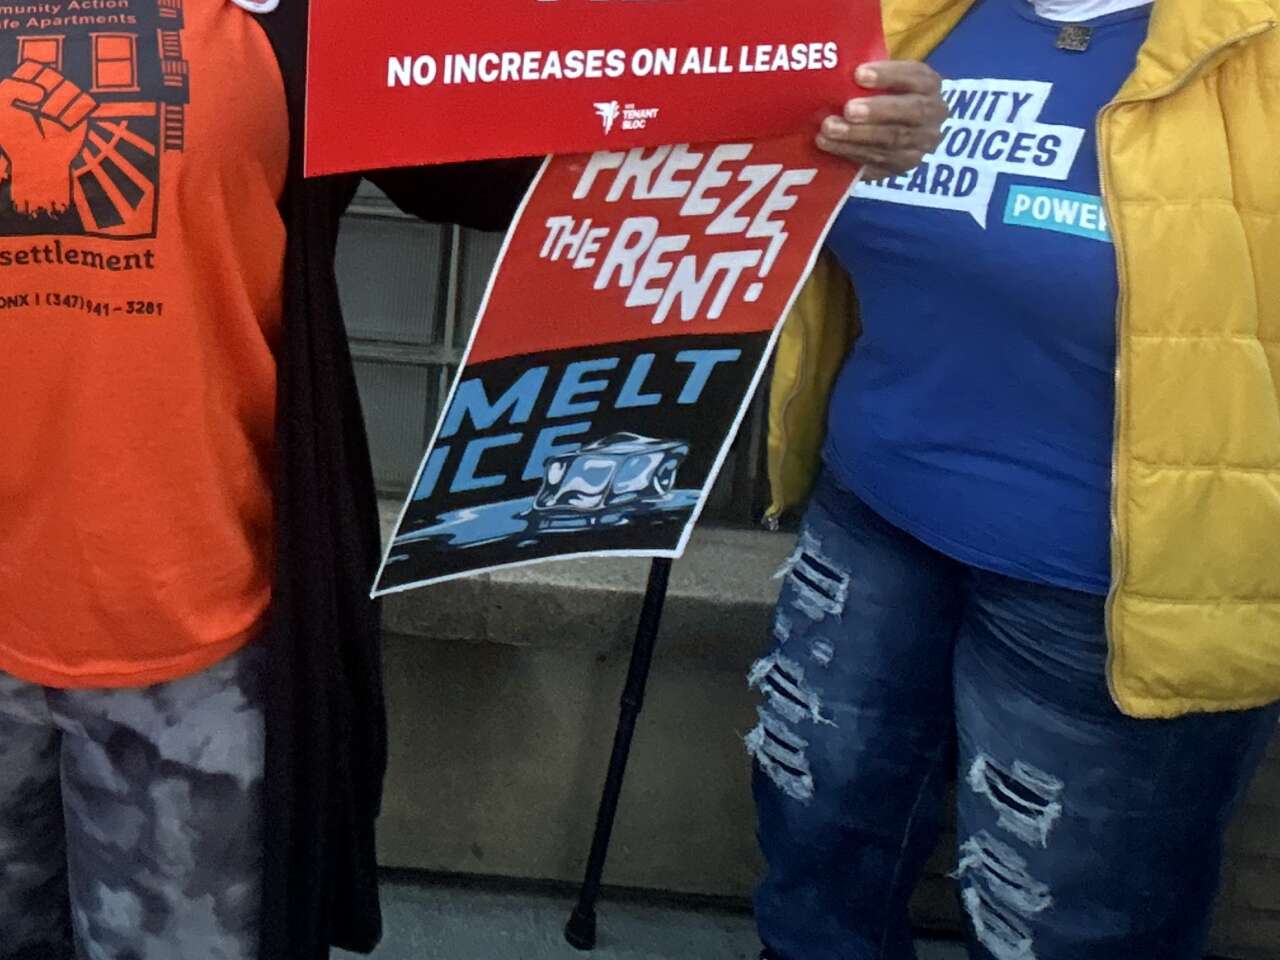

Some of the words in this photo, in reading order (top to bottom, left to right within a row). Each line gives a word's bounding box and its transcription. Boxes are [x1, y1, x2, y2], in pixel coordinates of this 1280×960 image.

[26, 13, 136, 29] Apartments
[387, 55, 436, 88] NO
[443, 50, 626, 85] INCREASES
[631, 47, 677, 76] ON
[681, 46, 734, 75] ALL
[738, 43, 838, 72] LEASES
[941, 126, 1061, 167] OICES
[572, 143, 818, 238] FREEZE
[0, 240, 155, 271] settlement
[539, 216, 609, 270] THE
[593, 217, 789, 325] RENT!
[440, 348, 742, 438] MELT
[413, 422, 593, 501] ICE
